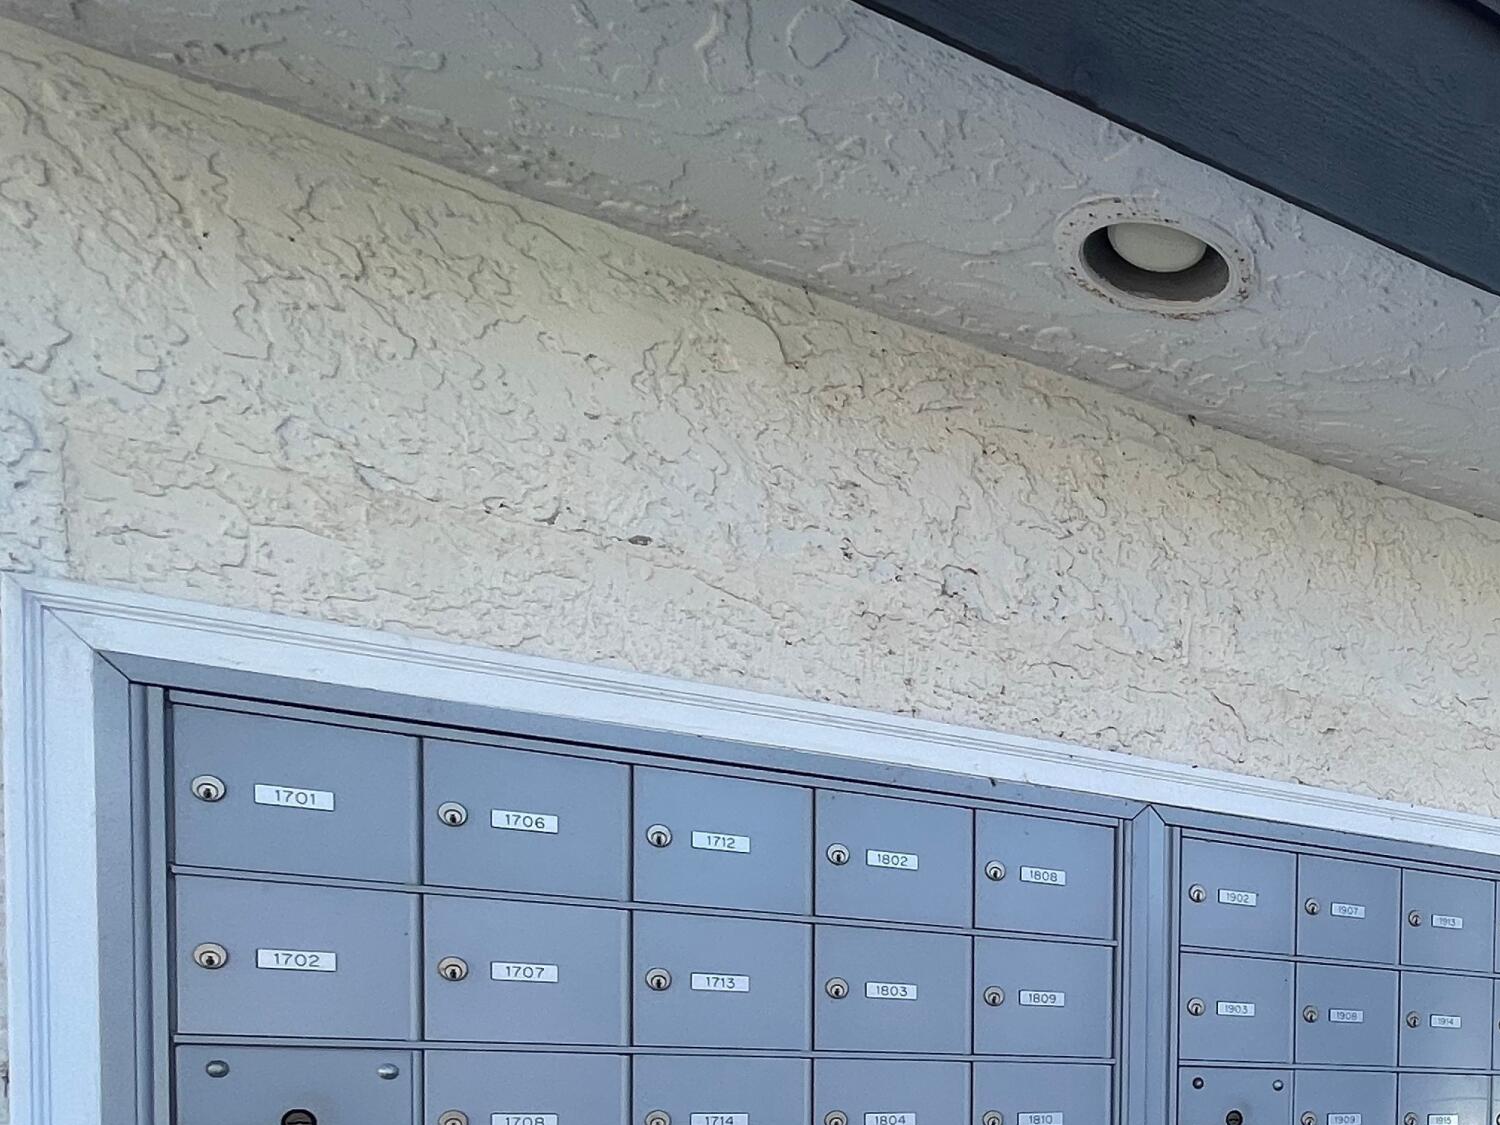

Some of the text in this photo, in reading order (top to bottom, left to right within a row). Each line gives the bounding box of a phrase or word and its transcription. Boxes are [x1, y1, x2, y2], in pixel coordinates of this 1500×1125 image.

[274, 789, 318, 806] 1701
[504, 814, 546, 829] 1706
[706, 835, 736, 849] 1712
[876, 853, 908, 867] 1802
[1029, 870, 1058, 883] 1808
[1226, 893, 1250, 903] 1902
[1338, 906, 1359, 915] 1907
[1439, 917, 1456, 926] 1913
[273, 952, 321, 968] 1702
[504, 966, 545, 979] 1707
[705, 976, 736, 990] 1713
[875, 984, 908, 997] 1803
[1028, 992, 1056, 1004] 1809
[1224, 1004, 1248, 1014] 1903
[1336, 1012, 1357, 1020] 1908
[874, 1114, 906, 1125] 1804
[1028, 1114, 1053, 1125] 1810
[1334, 1115, 1356, 1125] 1909
[1435, 1116, 1452, 1125] 1915
